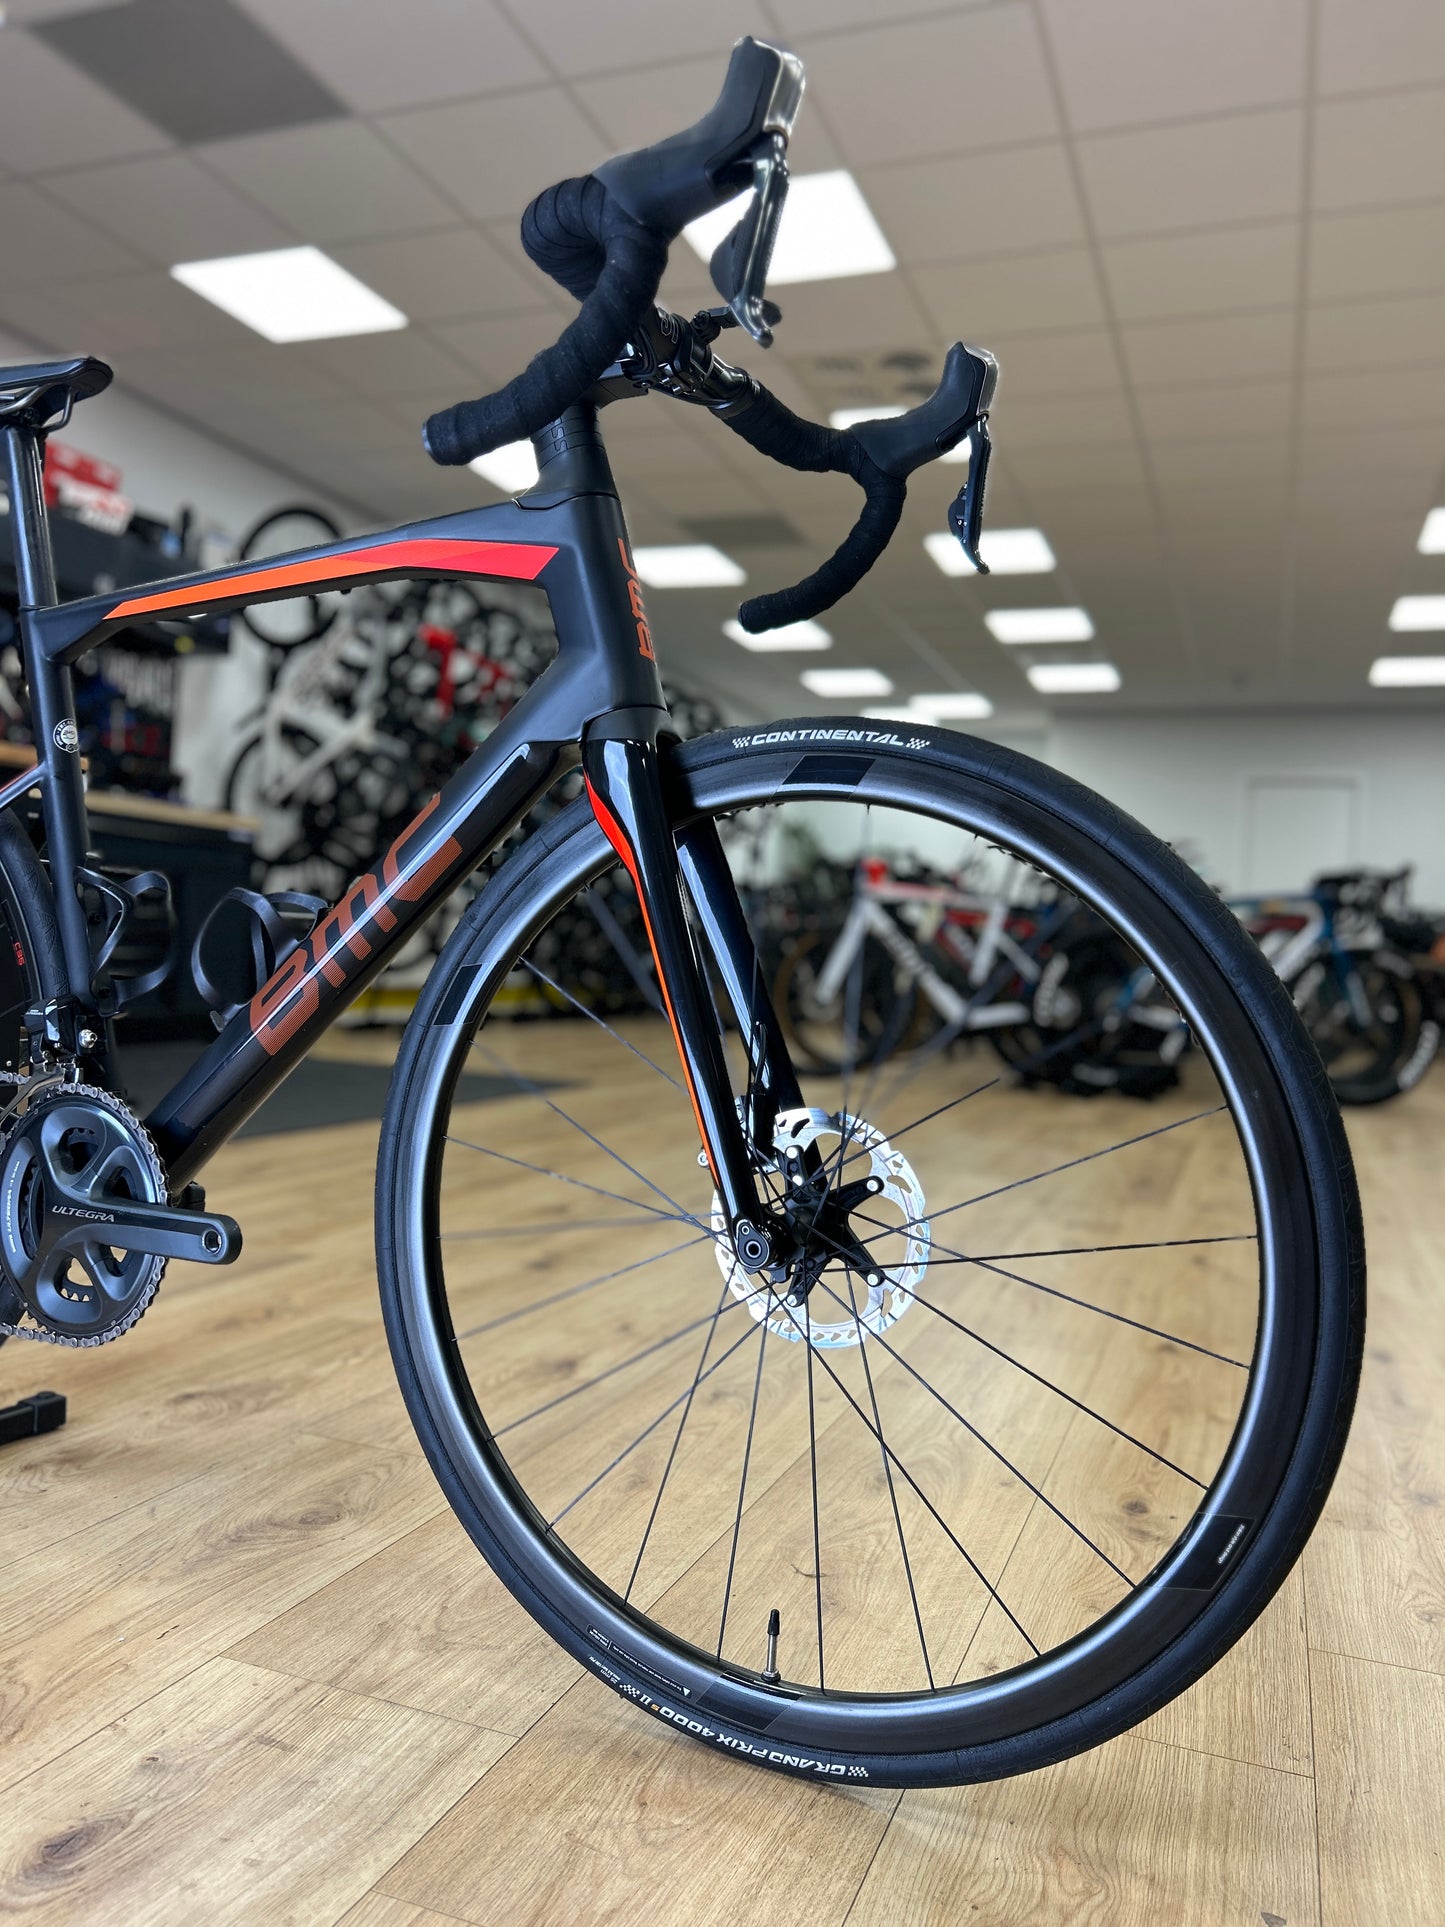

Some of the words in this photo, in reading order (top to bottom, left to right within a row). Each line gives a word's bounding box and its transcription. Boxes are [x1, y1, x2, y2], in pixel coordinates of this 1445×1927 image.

[751, 729, 904, 746] CONTINENTAL
[249, 791, 463, 1056] BMC
[52, 1205, 115, 1222] ULTEGRA
